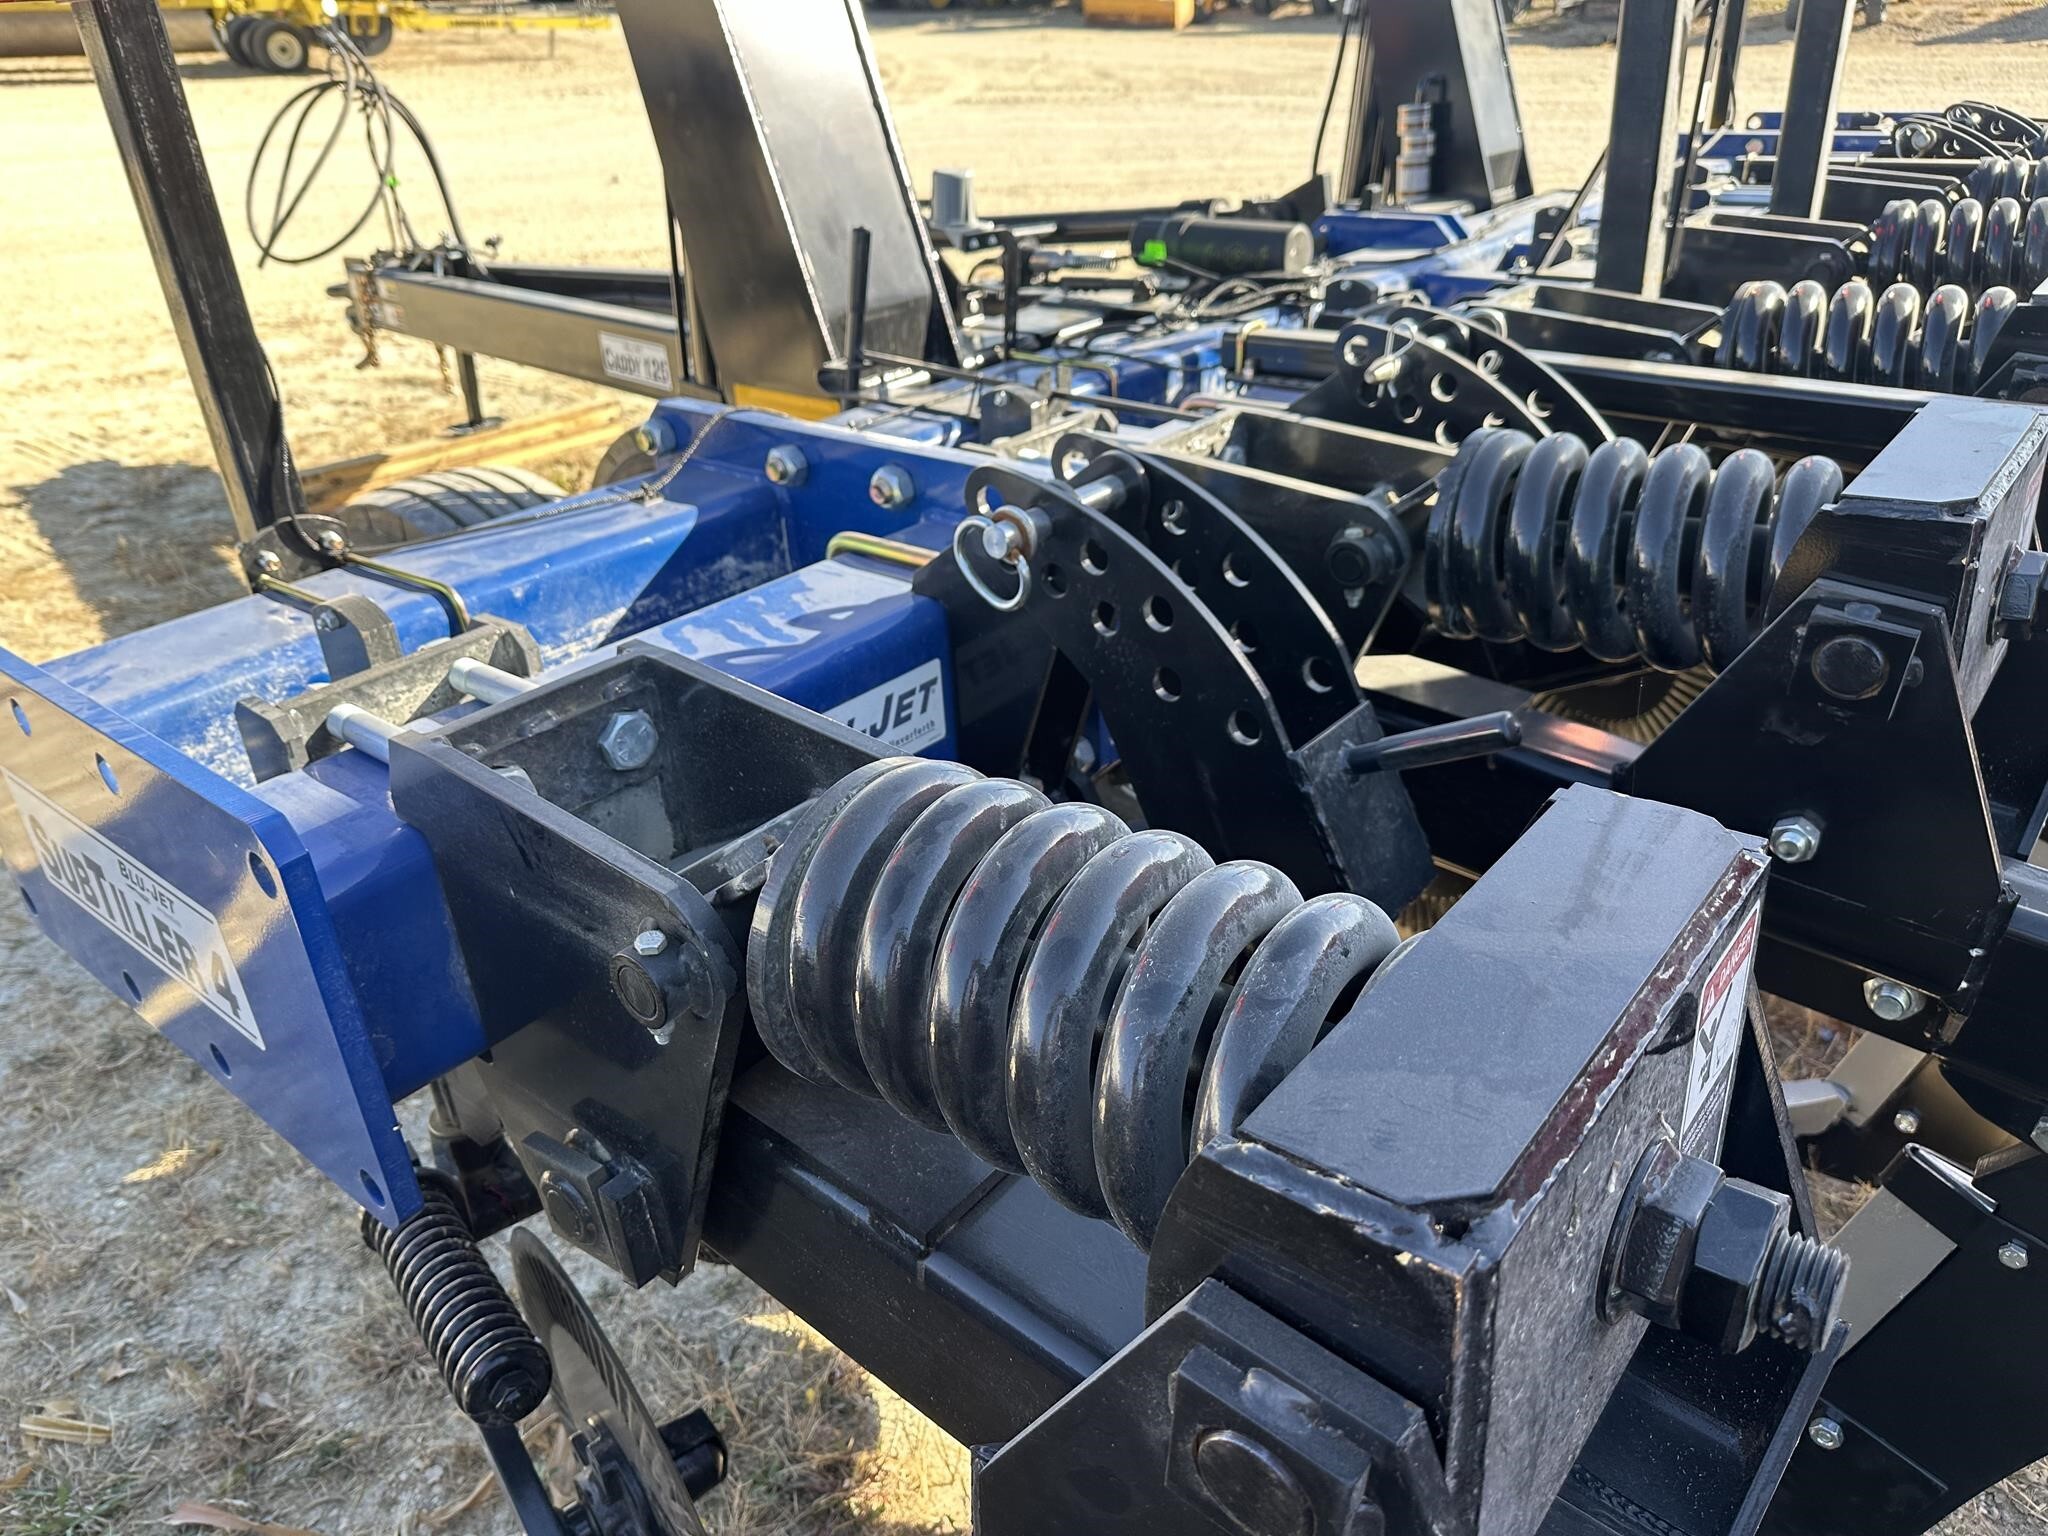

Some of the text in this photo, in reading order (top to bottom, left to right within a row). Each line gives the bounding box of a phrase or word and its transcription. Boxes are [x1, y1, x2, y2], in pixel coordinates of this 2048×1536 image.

[117, 859, 175, 914] BLU-JET
[211, 950, 241, 1021] 4
[1718, 926, 1753, 987] DANGER
